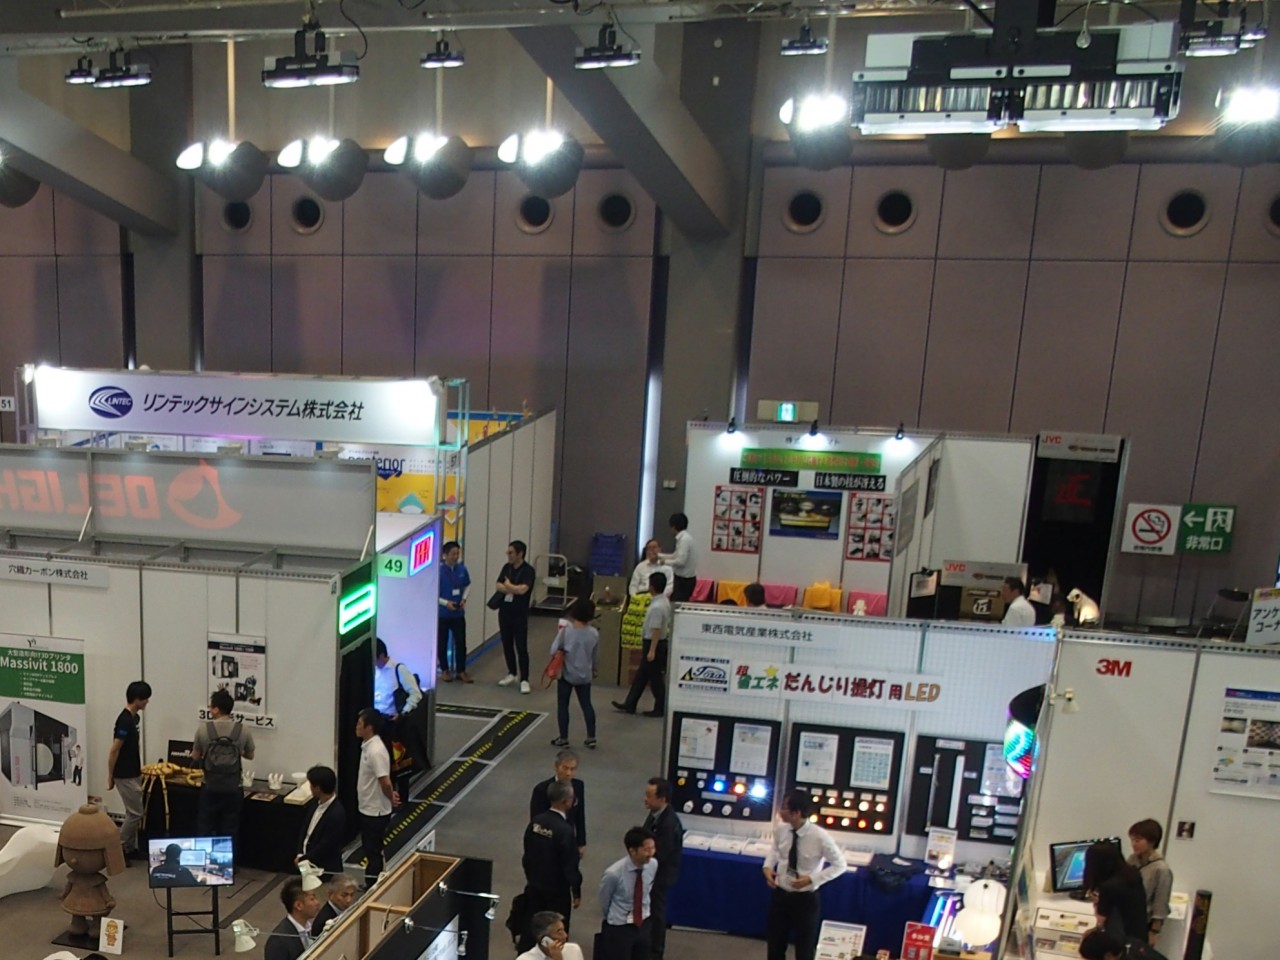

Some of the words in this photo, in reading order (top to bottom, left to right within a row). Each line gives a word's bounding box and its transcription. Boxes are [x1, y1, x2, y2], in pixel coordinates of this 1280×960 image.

[0, 398, 12, 410] 51
[143, 392, 365, 421] リンテックサインシステム株式会社
[1042, 434, 1062, 444] JVC
[1185, 535, 1224, 552] 非常口
[8, 564, 89, 580] 穴織カーボン株式会社
[384, 558, 403, 573] 49
[945, 563, 967, 572] JVC
[701, 622, 814, 642] 東西電気産業株式会社
[0, 656, 48, 671] Massivit
[50, 661, 79, 675] 1800
[1096, 658, 1133, 678] 3M
[737, 674, 779, 691] 省エネ
